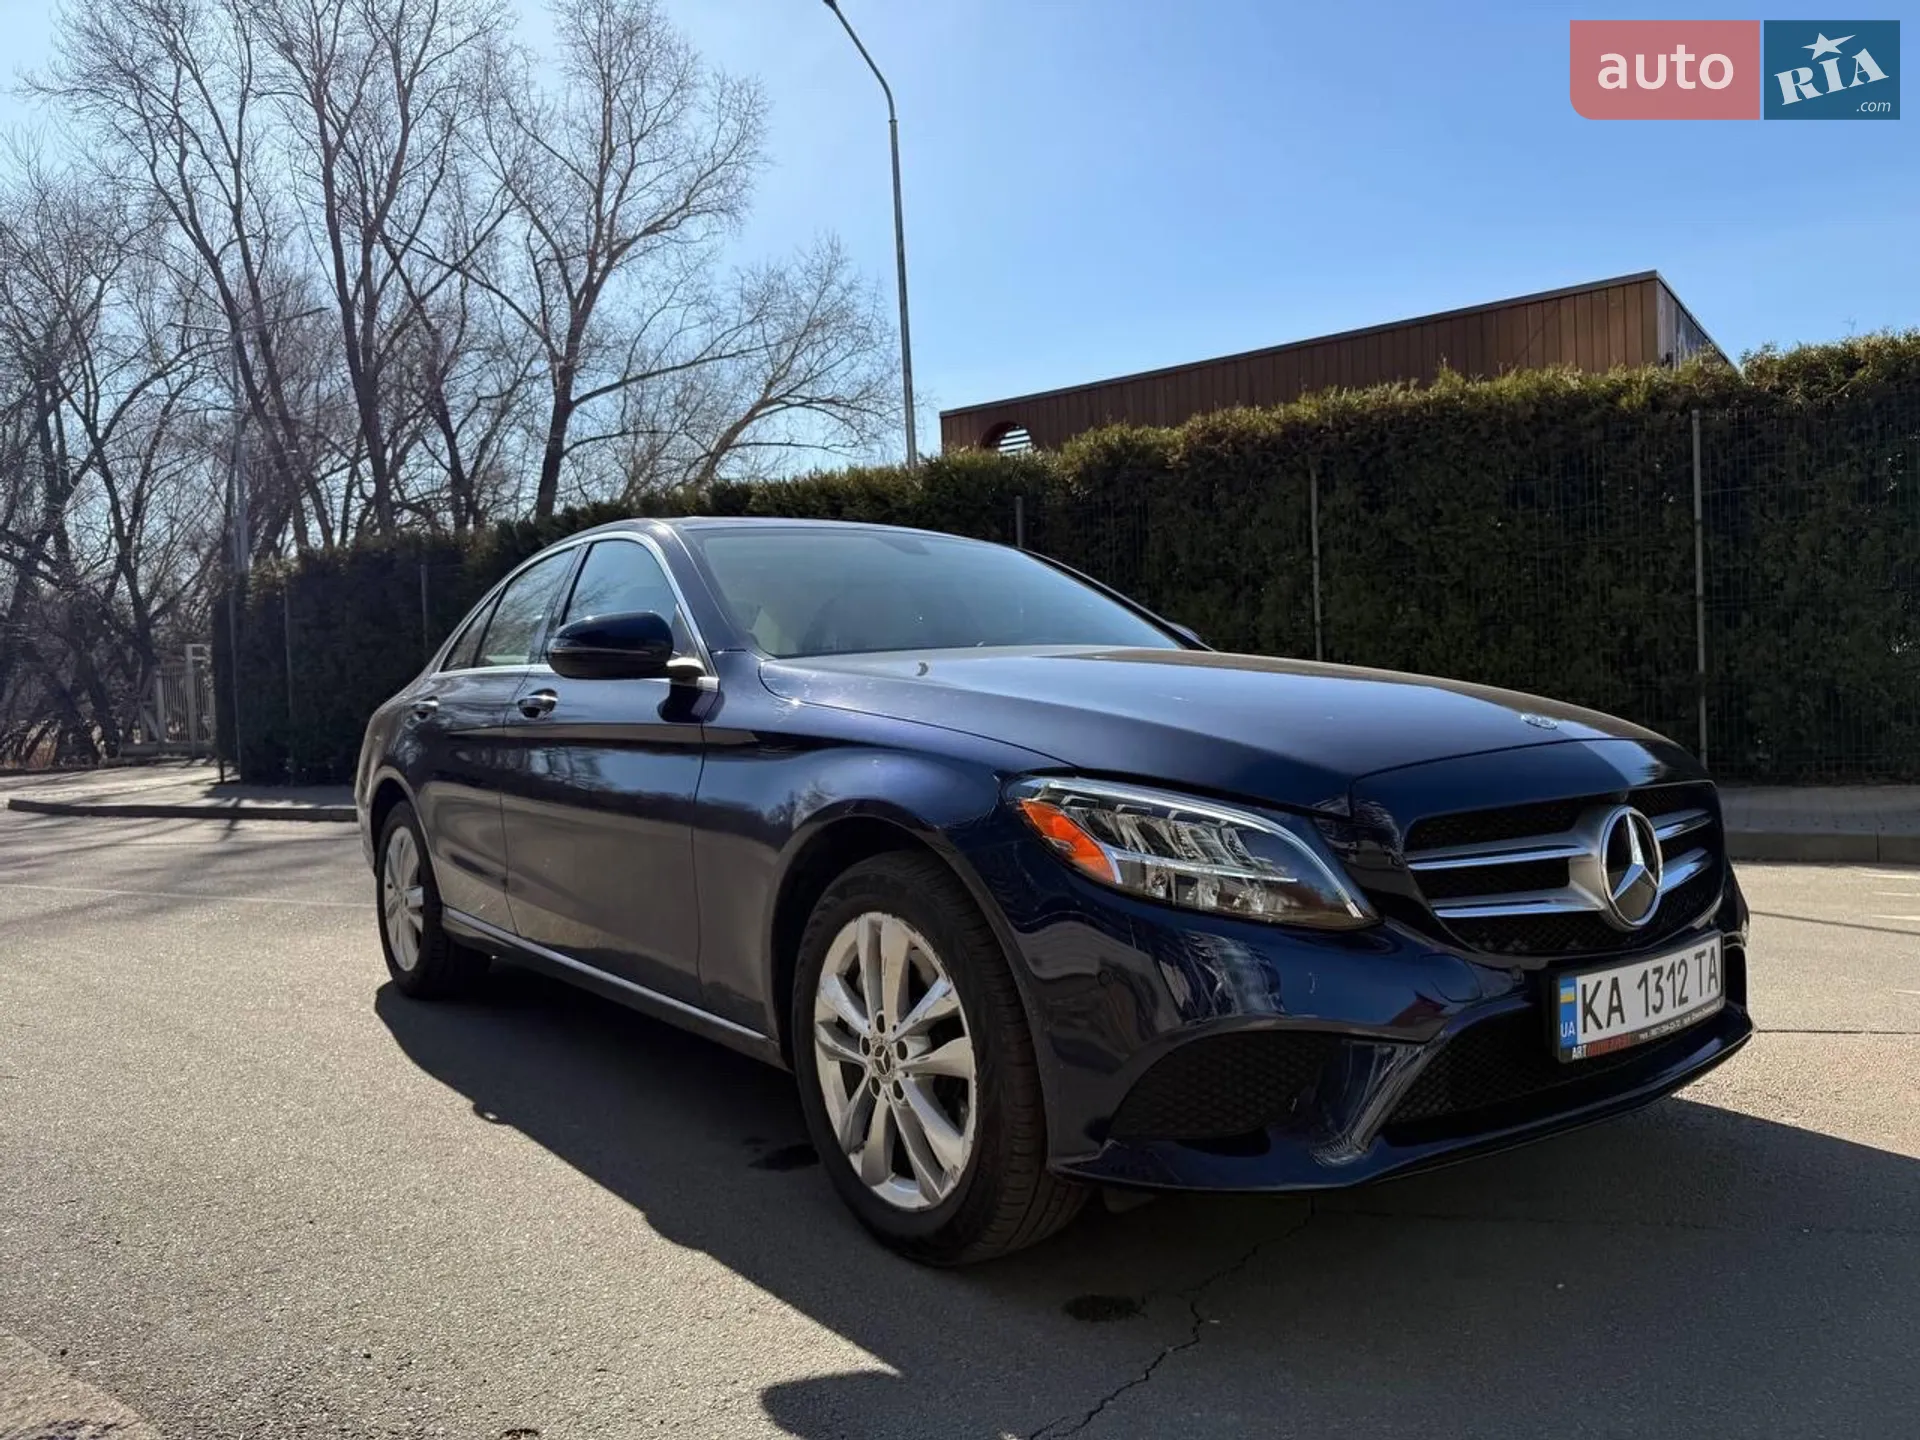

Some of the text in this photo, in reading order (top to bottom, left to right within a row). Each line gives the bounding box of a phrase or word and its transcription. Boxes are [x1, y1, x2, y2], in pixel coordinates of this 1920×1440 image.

[1581, 976, 1625, 1033] KA
[1637, 958, 1688, 1018] 1312
[1694, 946, 1719, 997] TA
[1560, 1021, 1576, 1038] UA
